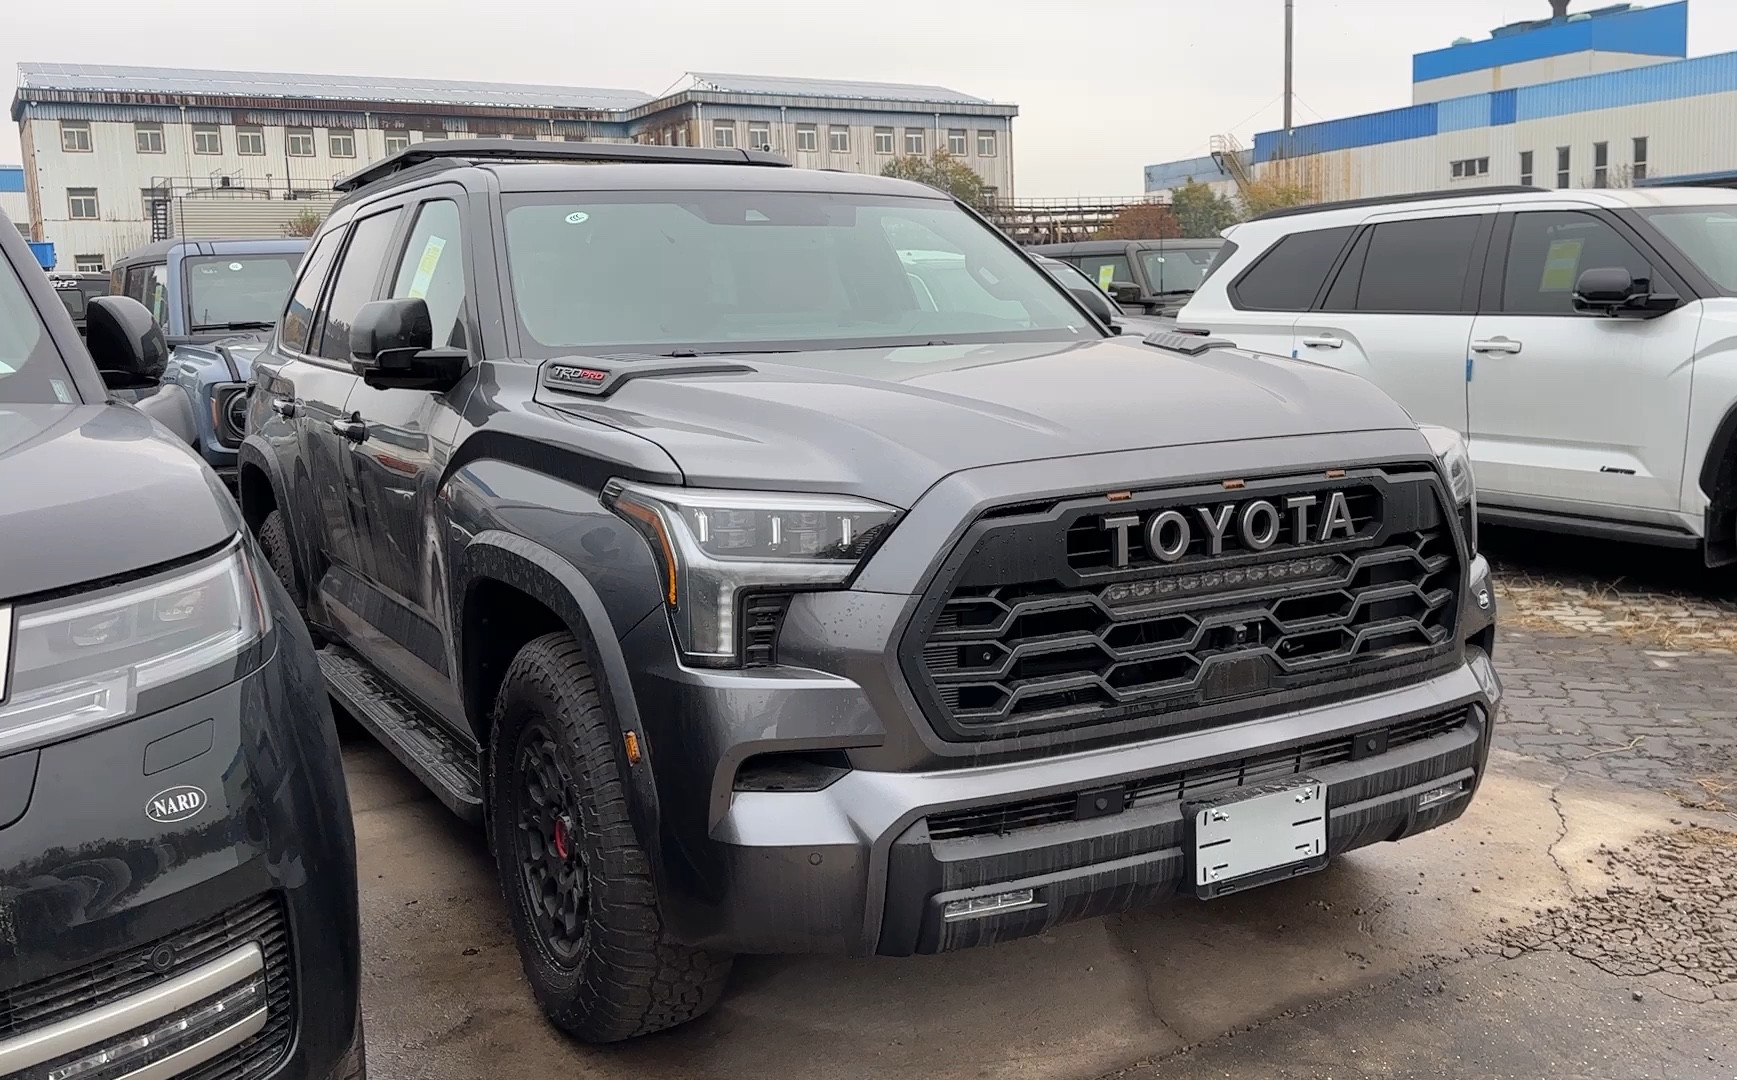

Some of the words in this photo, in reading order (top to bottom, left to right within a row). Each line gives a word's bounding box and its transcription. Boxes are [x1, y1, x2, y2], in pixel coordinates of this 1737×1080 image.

[555, 366, 582, 380] TRD
[581, 370, 605, 380] PRO
[1102, 492, 1355, 567] TOYOTA
[153, 791, 200, 817] NARD
